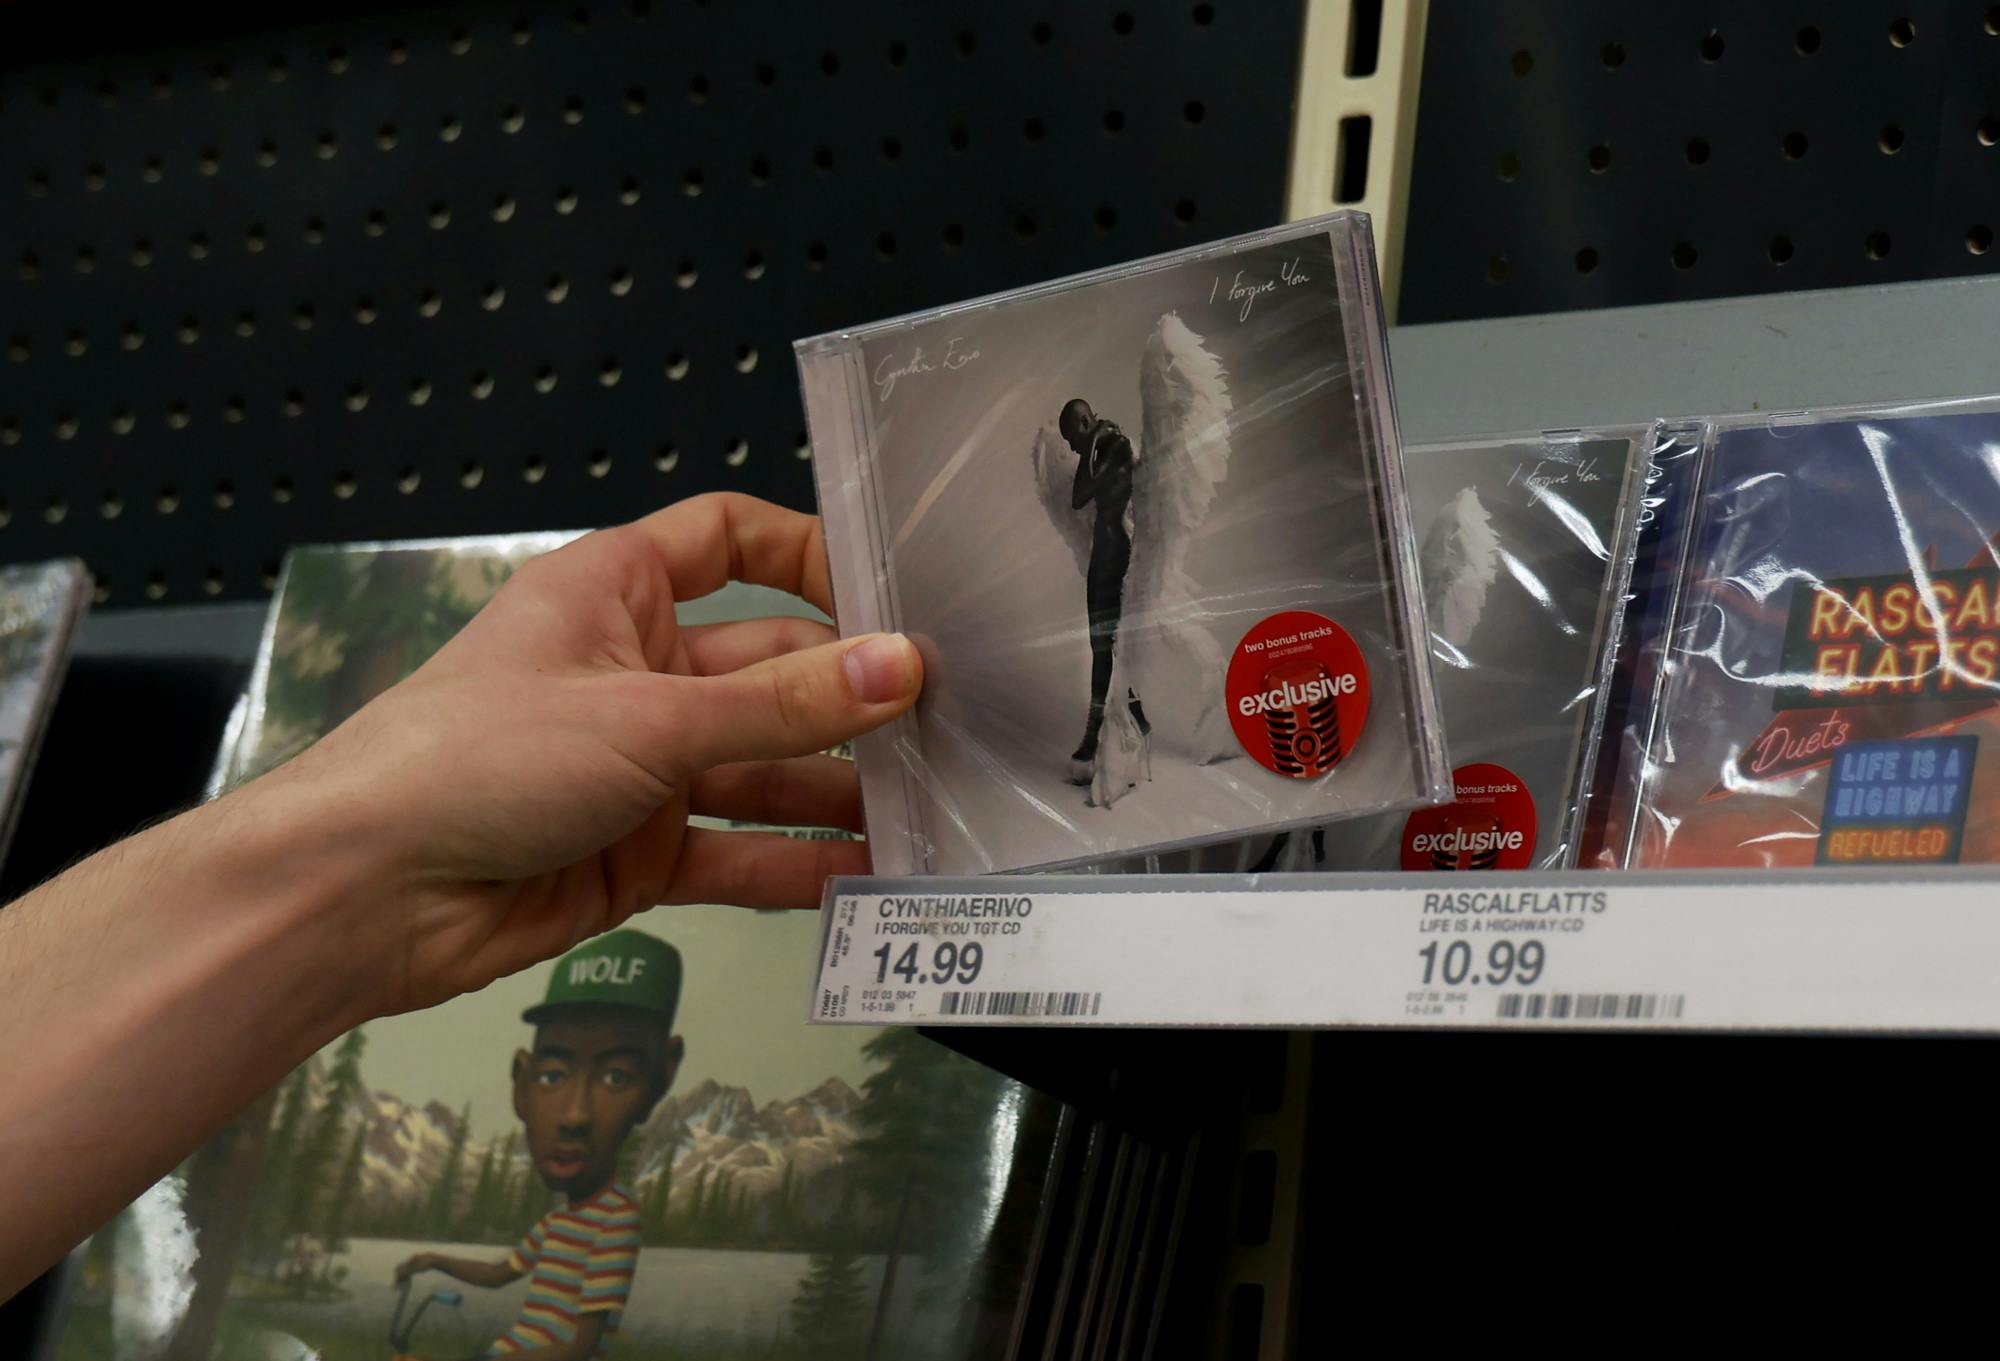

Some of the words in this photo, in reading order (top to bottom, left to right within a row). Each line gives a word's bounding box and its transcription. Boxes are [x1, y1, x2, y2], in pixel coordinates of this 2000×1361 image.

[1281, 257, 1311, 287] You
[1576, 457, 1601, 483] You
[1244, 642, 1265, 654] two
[1266, 633, 1299, 649] bonus
[1299, 626, 1333, 642] tracks
[1812, 640, 1996, 692] FLATTS
[1239, 672, 1357, 717] exclusive
[1752, 709, 1849, 773] Duets
[1840, 752, 1900, 783] LIFE
[1910, 749, 1937, 779] IS
[1943, 748, 1960, 779] A
[1456, 784, 1485, 795] bonus
[1487, 783, 1518, 794] tracks
[1834, 784, 1958, 817] HIGHWAY
[1412, 825, 1524, 853] exclusive
[1828, 829, 1947, 858] REFUELED
[879, 897, 1033, 919] CYNTHIAERIVO
[1423, 892, 1608, 915] RASCALFLATTS
[875, 922, 880, 935] I
[882, 922, 940, 936] FORGIVE
[942, 922, 971, 935] YOU
[973, 922, 1000, 935] TGT
[1002, 922, 1022, 935] CD
[1419, 919, 1451, 933] LIFE
[1454, 919, 1469, 933] IS
[1472, 919, 1482, 933] A
[569, 956, 647, 986] WOLF
[873, 941, 984, 985] 14.99
[1418, 939, 1546, 986] 10.99
